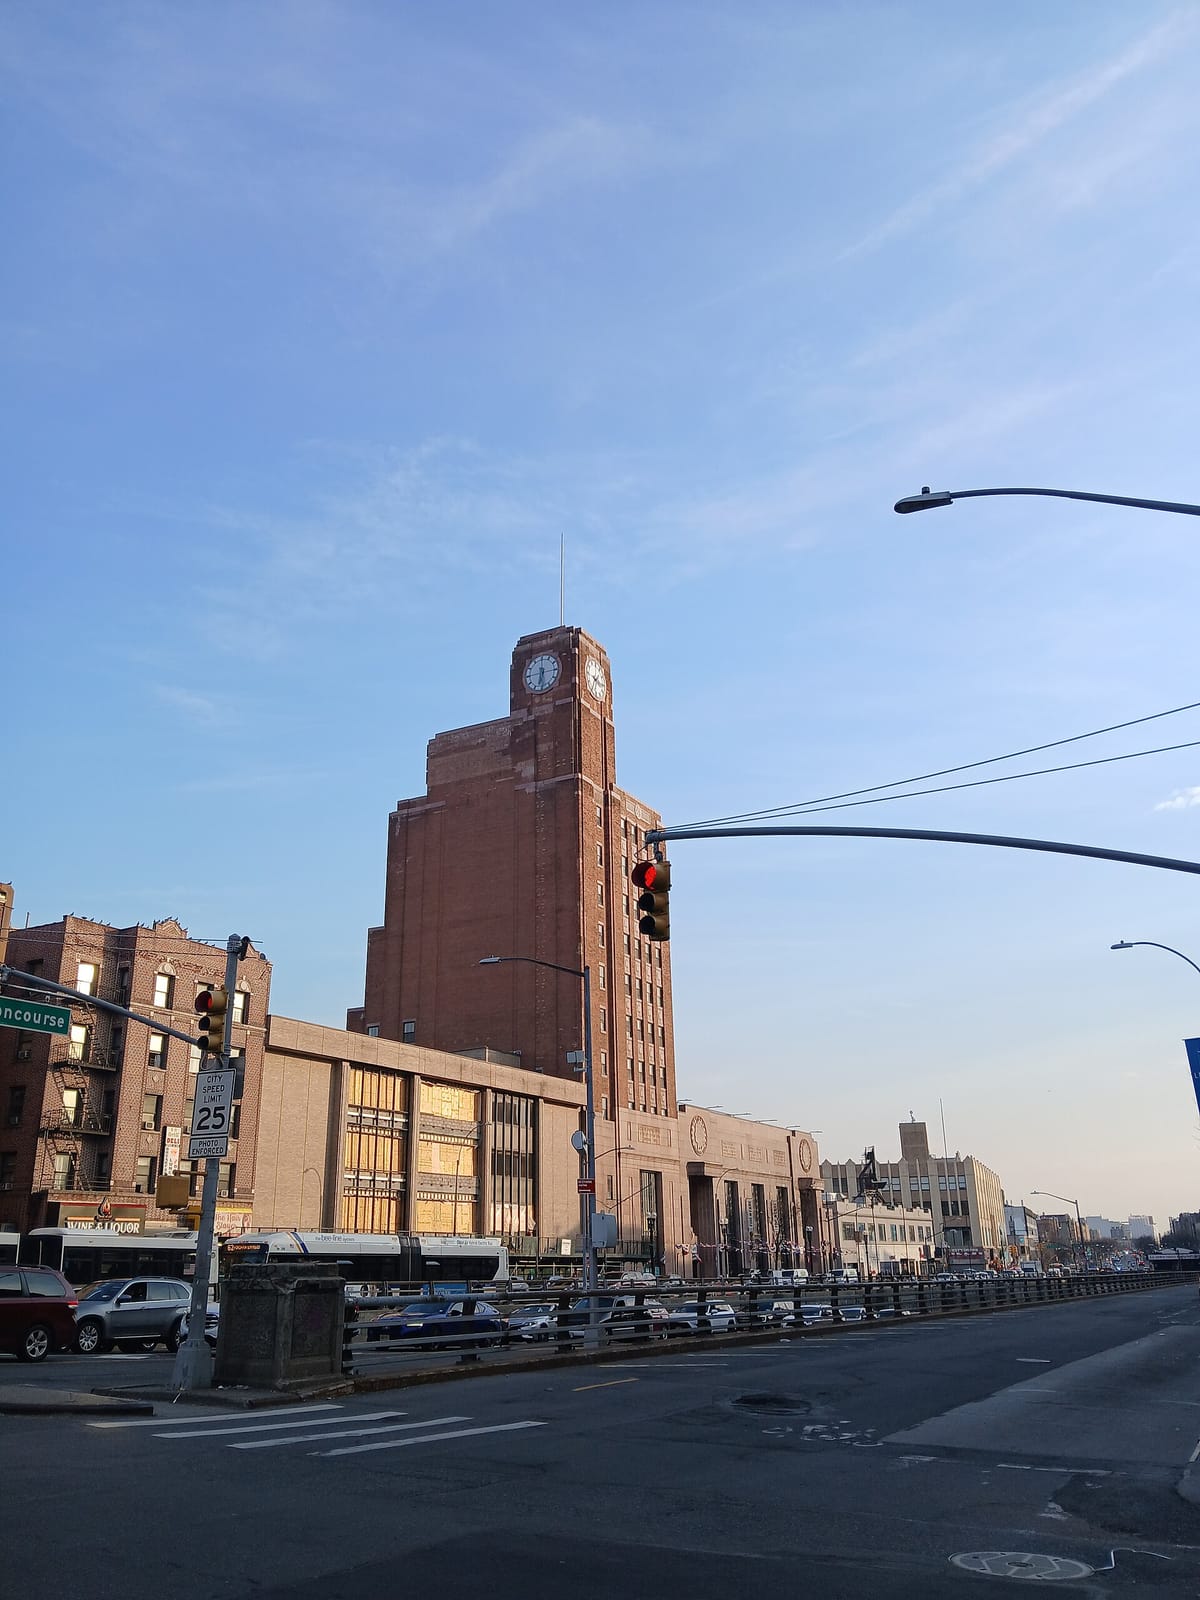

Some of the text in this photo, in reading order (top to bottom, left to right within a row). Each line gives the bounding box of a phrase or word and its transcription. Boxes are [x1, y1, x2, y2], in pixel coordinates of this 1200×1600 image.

[0, 1007, 65, 1028] ncourse
[206, 1075, 223, 1083] CITY
[202, 1085, 225, 1094] SPEED
[203, 1095, 222, 1103] LIMIT
[196, 1106, 226, 1130] 25
[191, 1147, 224, 1156] ENFORCED
[67, 1221, 95, 1230] WINE
[105, 1221, 140, 1234] LIQUOR
